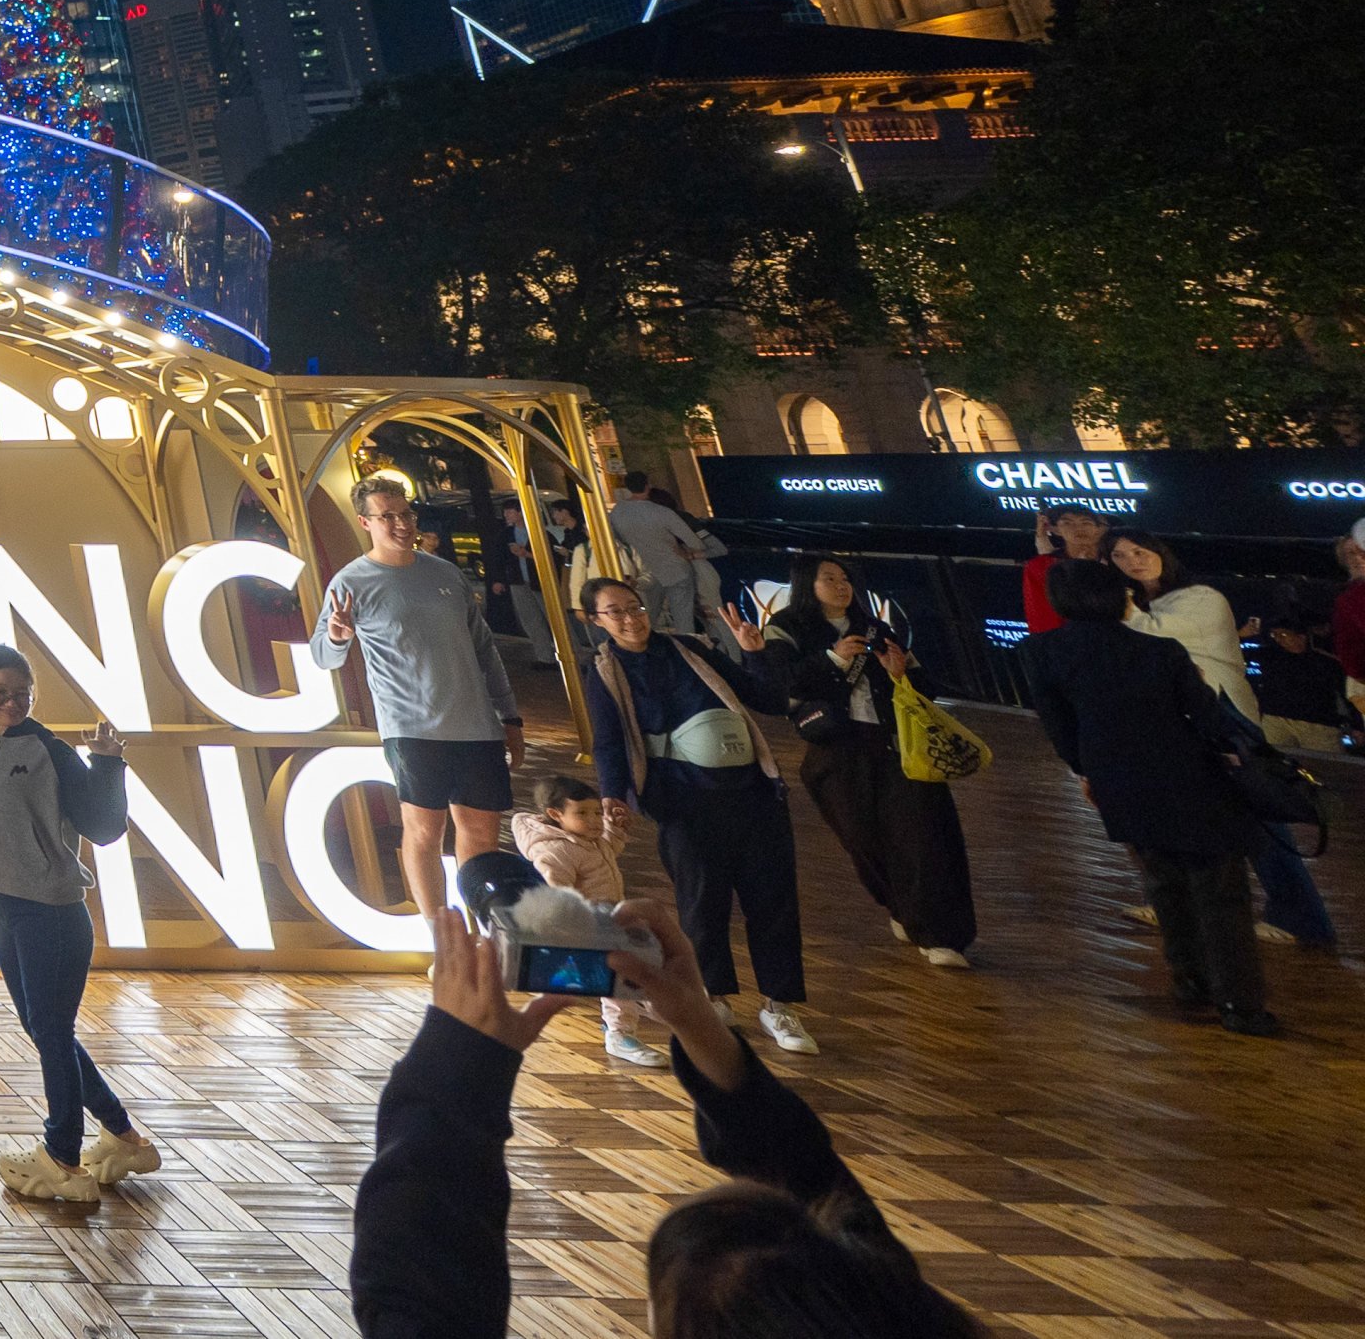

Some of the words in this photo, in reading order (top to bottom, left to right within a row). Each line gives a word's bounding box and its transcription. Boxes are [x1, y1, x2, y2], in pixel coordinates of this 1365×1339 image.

[976, 462, 1149, 490] CHANEL
[781, 479, 824, 491] COCO
[826, 479, 883, 492] CRUSH
[1289, 482, 1365, 498] COCO
[999, 496, 1040, 510] FINE
